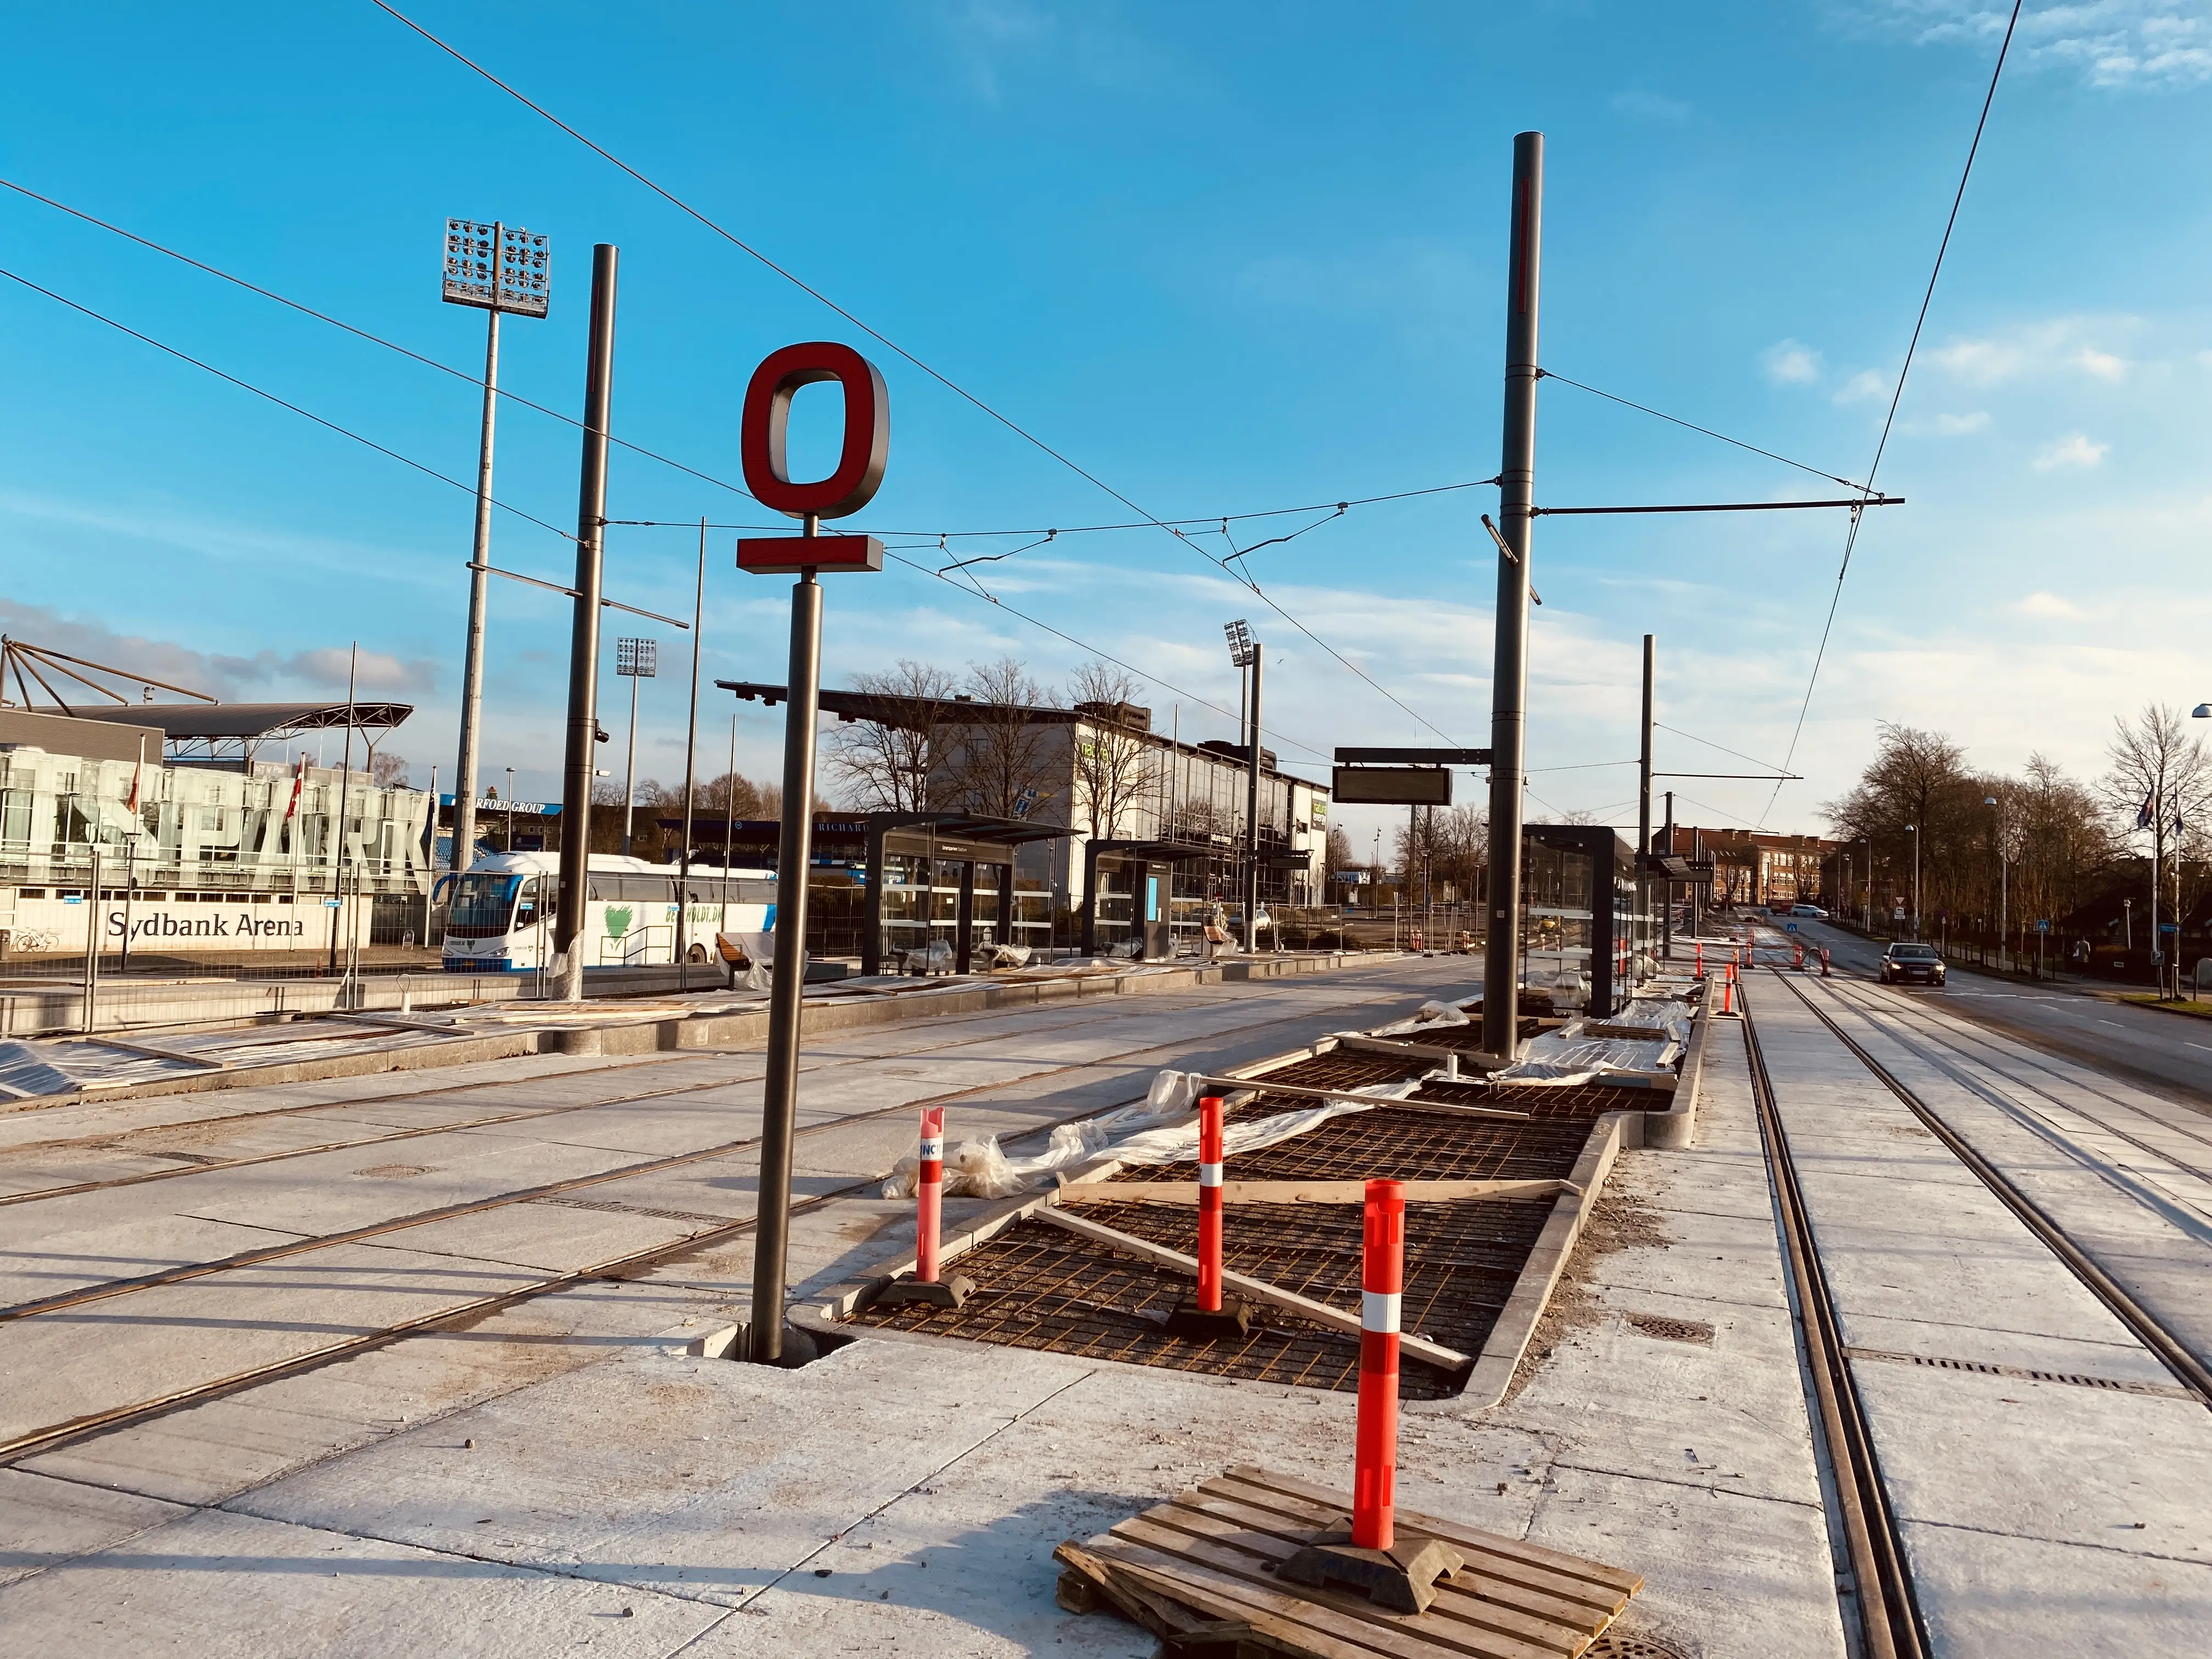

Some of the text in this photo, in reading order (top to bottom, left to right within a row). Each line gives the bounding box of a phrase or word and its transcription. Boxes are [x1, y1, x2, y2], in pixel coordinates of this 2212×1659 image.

[511, 802, 545, 814] GROUP
[108, 912, 304, 943] Sydbank Arena
